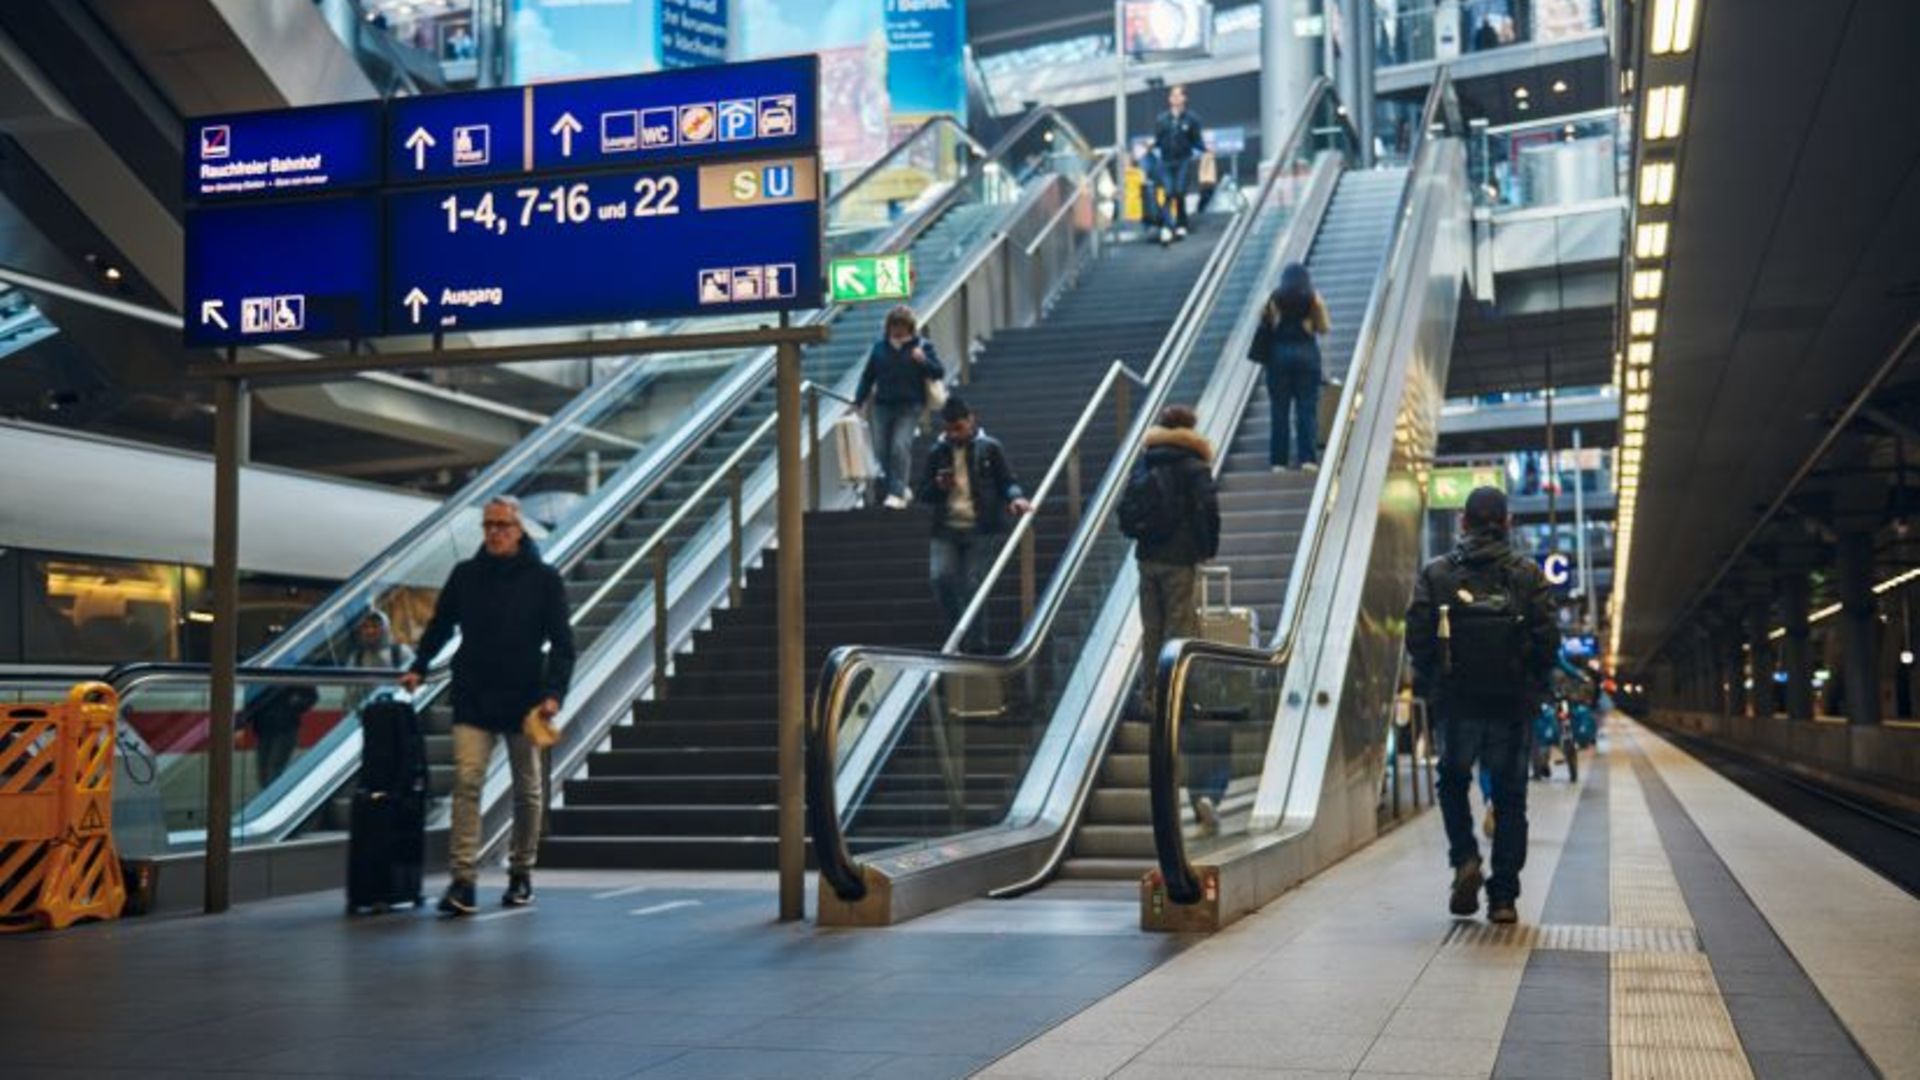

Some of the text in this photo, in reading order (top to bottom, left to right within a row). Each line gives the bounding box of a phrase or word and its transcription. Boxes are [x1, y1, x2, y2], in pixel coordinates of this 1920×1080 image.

[642, 125, 669, 144] WC
[270, 154, 321, 173] Bahnhof
[733, 168, 790, 200] S U
[441, 176, 680, 235] 1-4, 7-16 und 22
[441, 287, 503, 308] Ausgang
[1544, 553, 1569, 585] C
